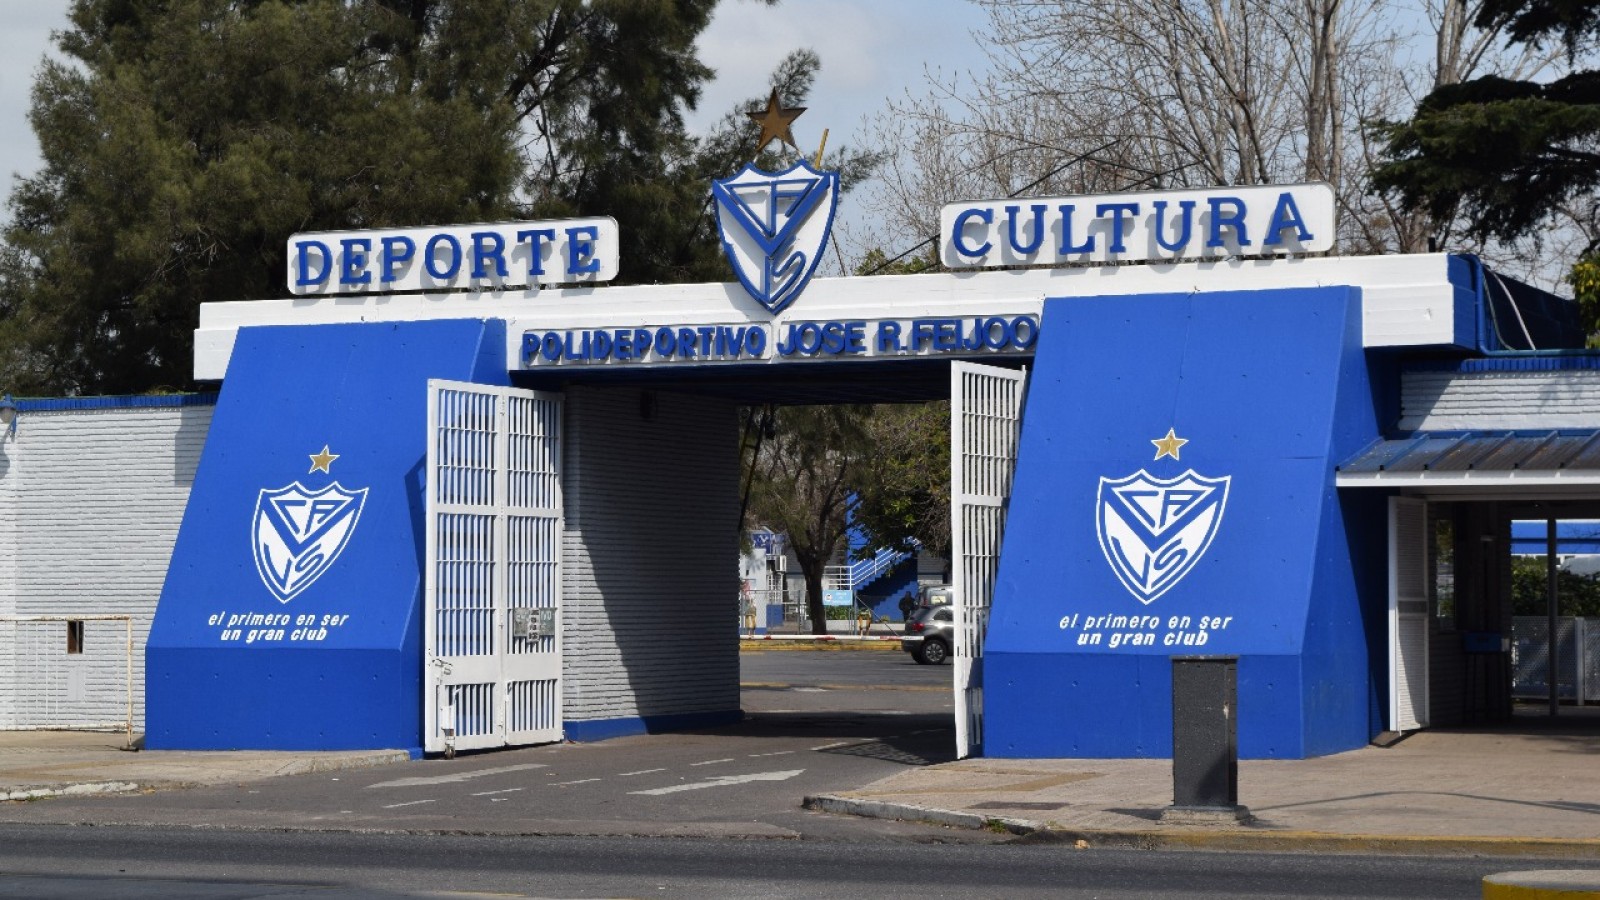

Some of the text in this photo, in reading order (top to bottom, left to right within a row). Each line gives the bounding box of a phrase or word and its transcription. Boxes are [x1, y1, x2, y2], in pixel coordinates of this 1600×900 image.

[952, 192, 1314, 258] CULTURA
[295, 226, 601, 287] DEPORTE
[522, 325, 767, 362] POLIDEPORTIVO
[777, 320, 867, 356] JOSE
[208, 611, 350, 628] el primero en ser
[1059, 613, 1233, 631] el primero en ser
[220, 626, 328, 645] un gran club
[1077, 629, 1209, 649] un gran club
